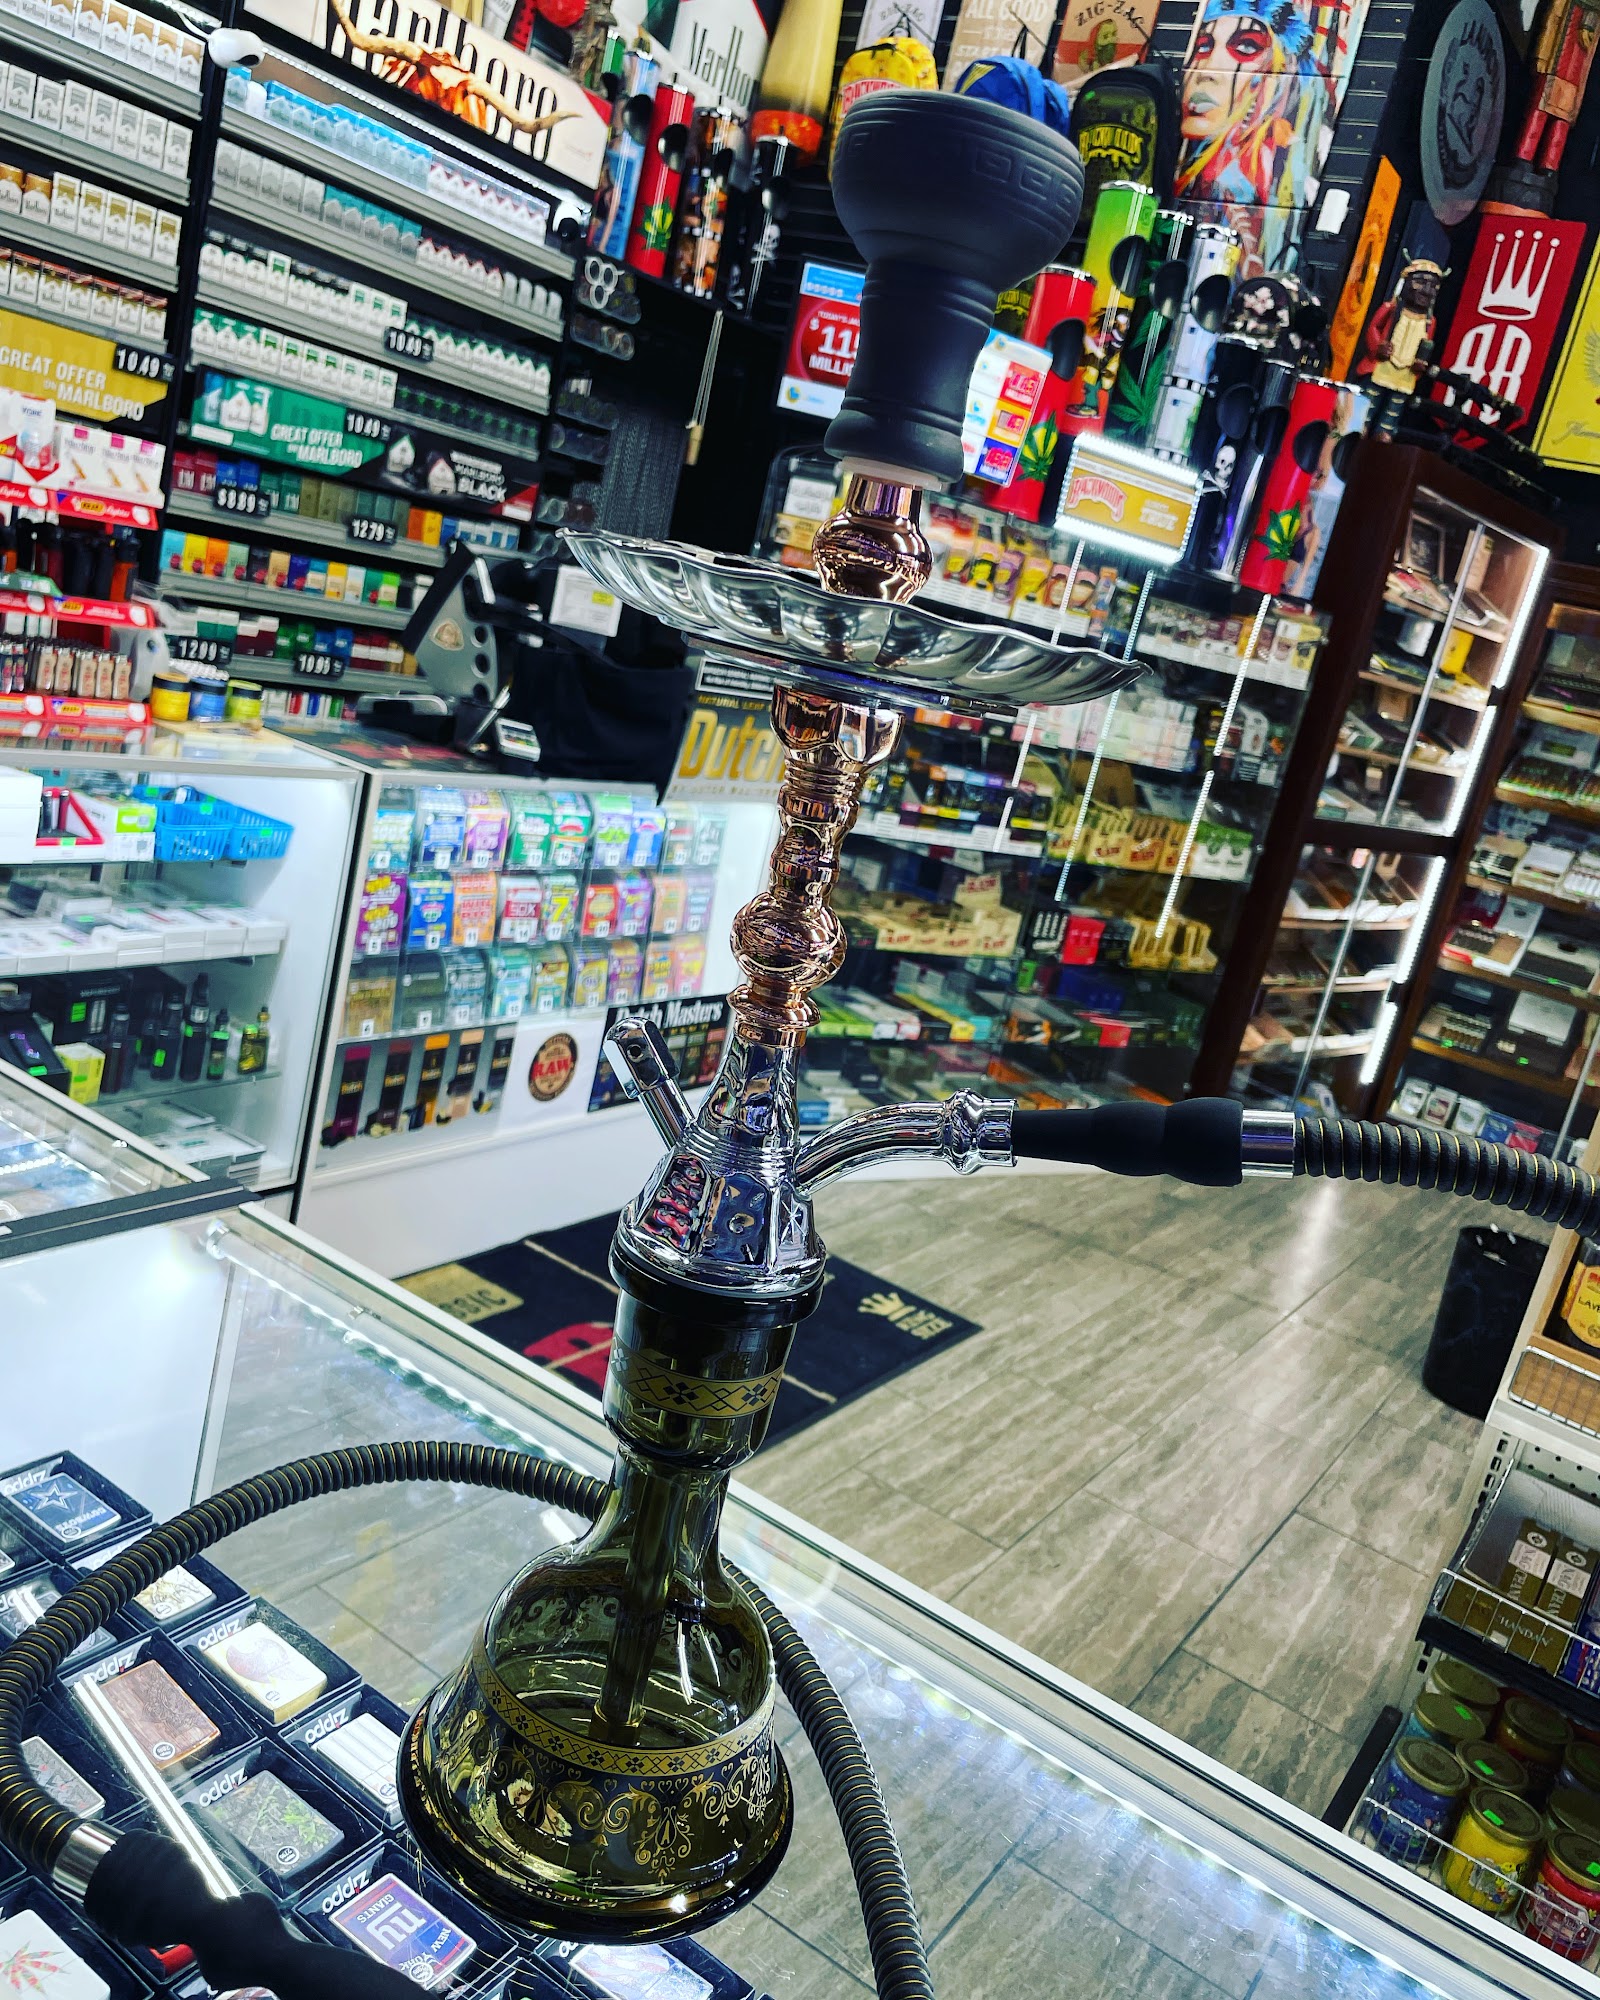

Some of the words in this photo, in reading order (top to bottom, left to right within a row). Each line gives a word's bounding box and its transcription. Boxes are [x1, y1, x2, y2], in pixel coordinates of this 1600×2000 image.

[56, 362, 107, 391] OFFER
[57, 381, 145, 422] MARLBORO
[270, 423, 310, 444] GREAT
[309, 428, 344, 448] OFFER
[297, 445, 364, 469] MARLBORO
[457, 475, 508, 503] BLACK
[664, 999, 724, 1029] Masters
[532, 1056, 573, 1080] RAW
[3, 1469, 48, 1497] zippo
[197, 1619, 244, 1651] zippo
[304, 1706, 349, 1743] zippo
[198, 1767, 248, 1808] zippo
[321, 1868, 370, 1915] zippo
[355, 1893, 395, 1923] GIANTS
[429, 1927, 451, 1953] NEW
